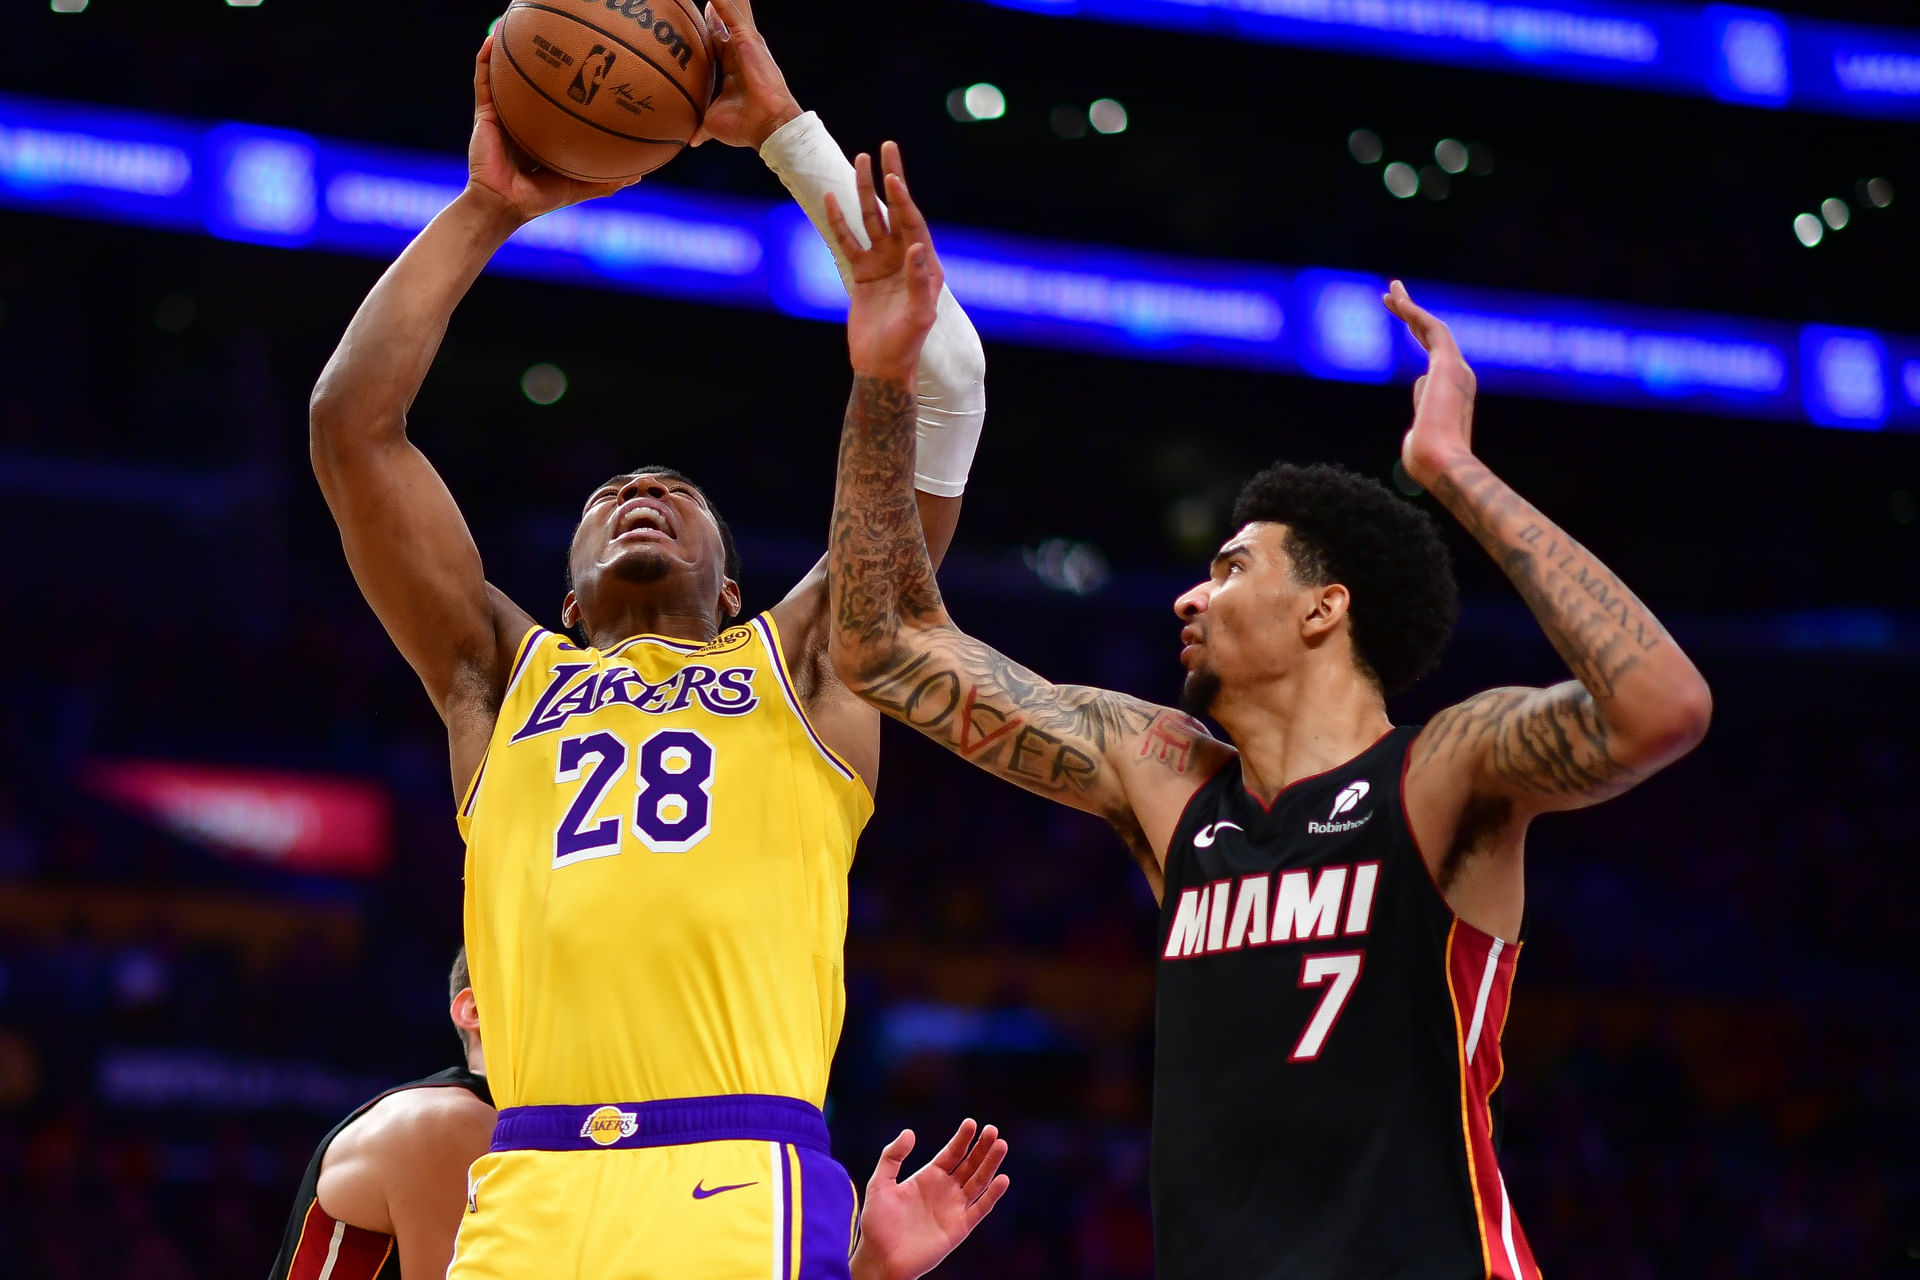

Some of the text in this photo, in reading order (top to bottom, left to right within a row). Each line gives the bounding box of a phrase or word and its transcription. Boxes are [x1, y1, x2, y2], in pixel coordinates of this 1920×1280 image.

[508, 663, 760, 747] LAKERS
[552, 727, 717, 870] 28
[1161, 860, 1382, 960] MIAMI
[1287, 951, 1365, 1063] 7
[583, 1116, 634, 1135] LAKERS
